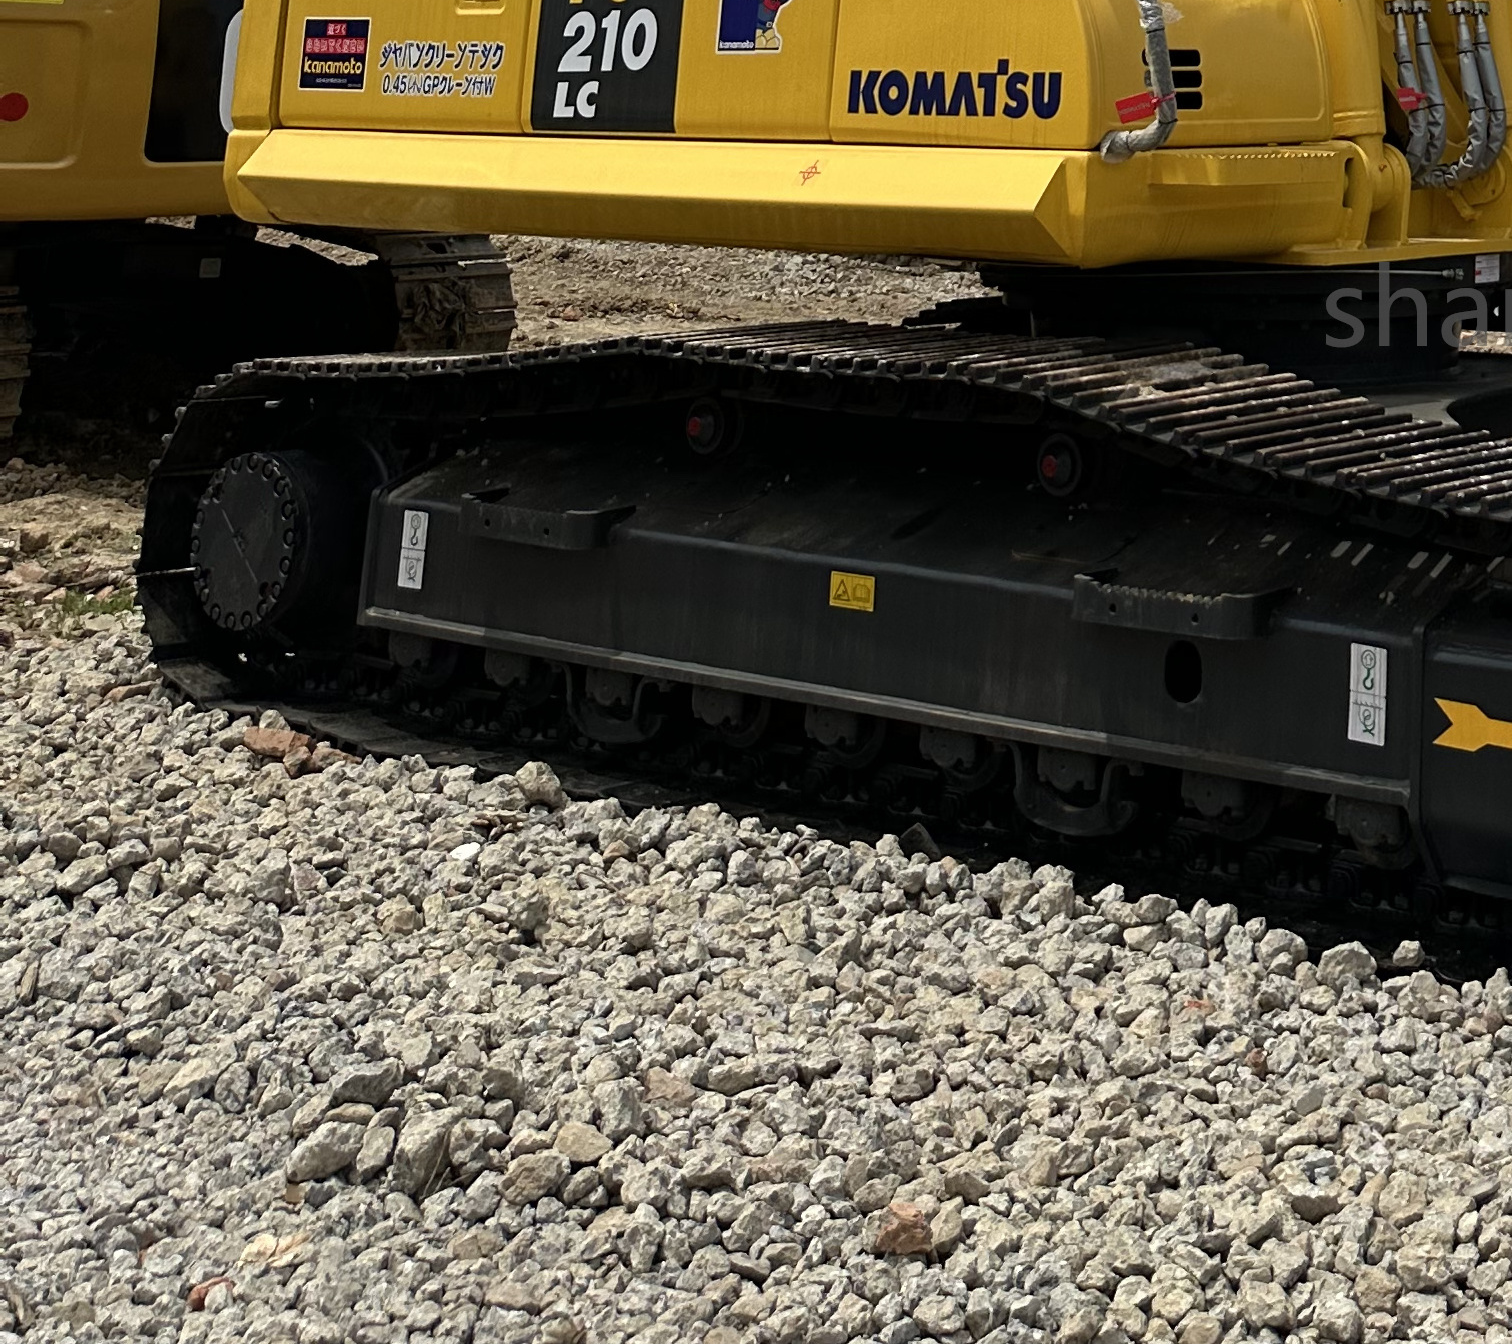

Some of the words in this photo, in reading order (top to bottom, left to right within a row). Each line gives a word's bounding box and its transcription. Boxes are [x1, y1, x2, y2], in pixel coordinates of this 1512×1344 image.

[557, 8, 658, 72] 210
[303, 56, 363, 74] kanamoto
[848, 58, 1063, 119] KOMATSU
[552, 80, 600, 118] LC
